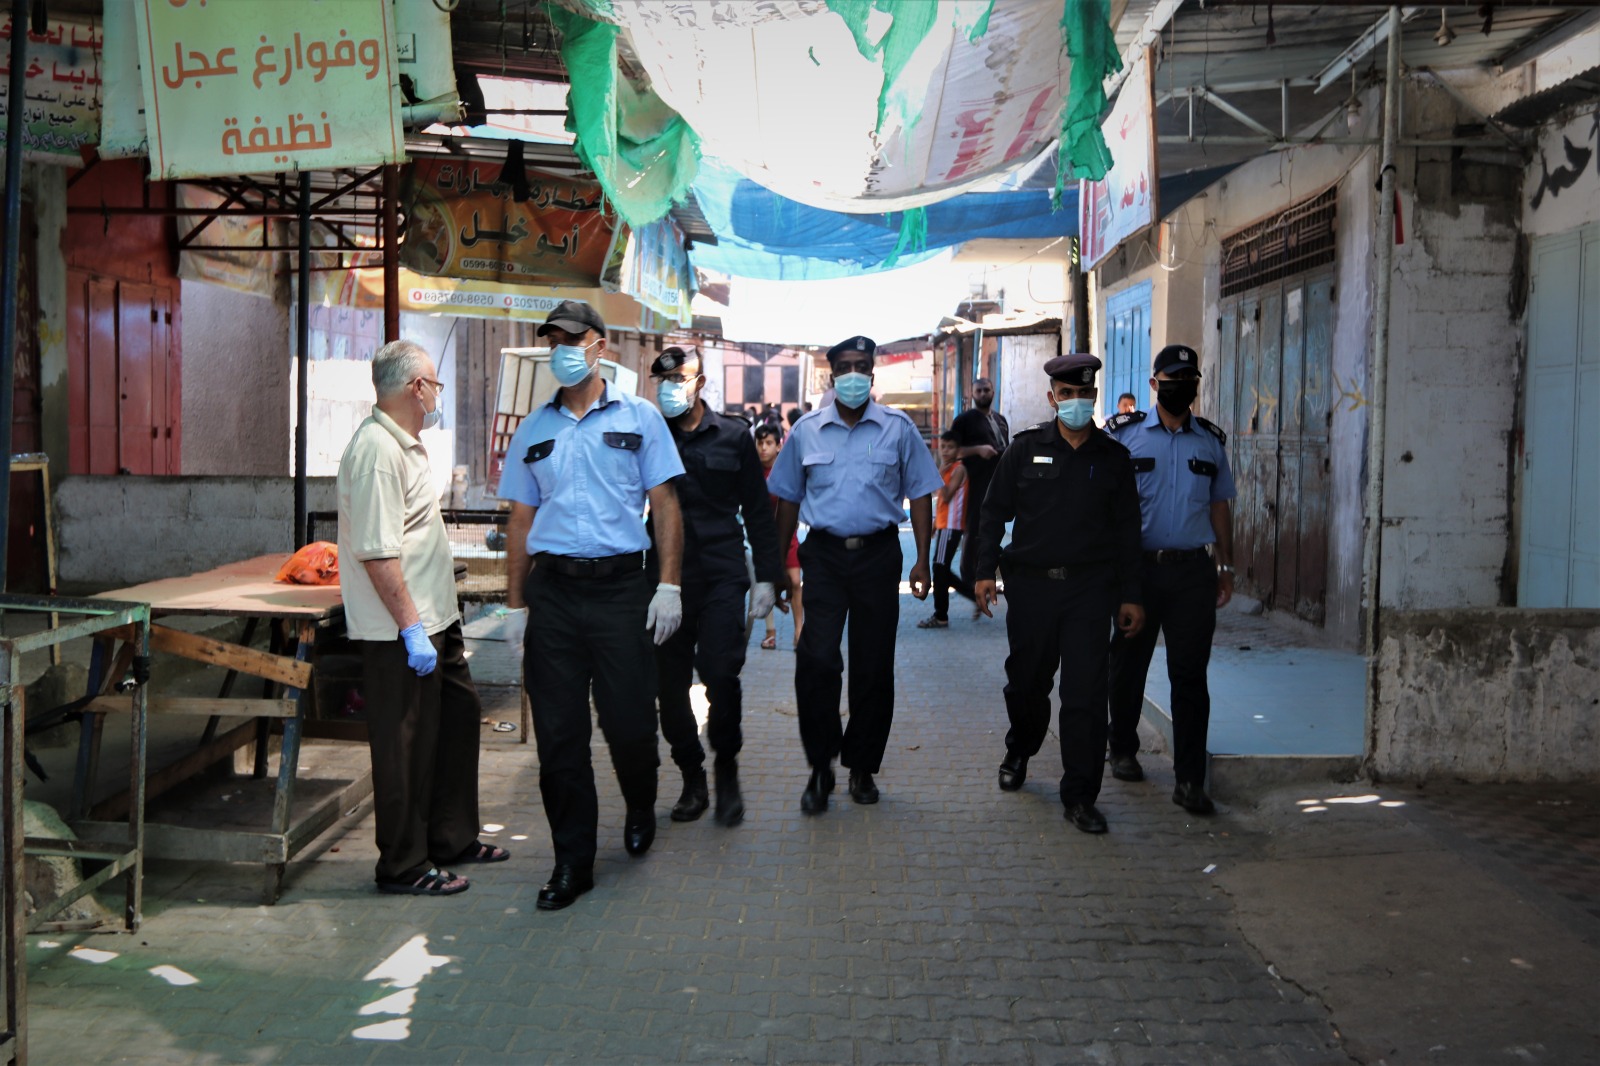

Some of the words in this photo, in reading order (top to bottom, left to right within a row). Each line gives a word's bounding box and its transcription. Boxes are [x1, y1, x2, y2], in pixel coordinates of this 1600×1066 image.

[162, 41, 238, 89] عجل
[252, 29, 380, 90] وفوارغ
[49, 112, 76, 126] جميع
[221, 111, 332, 163] نظيفة
[529, 223, 580, 265] أبو
